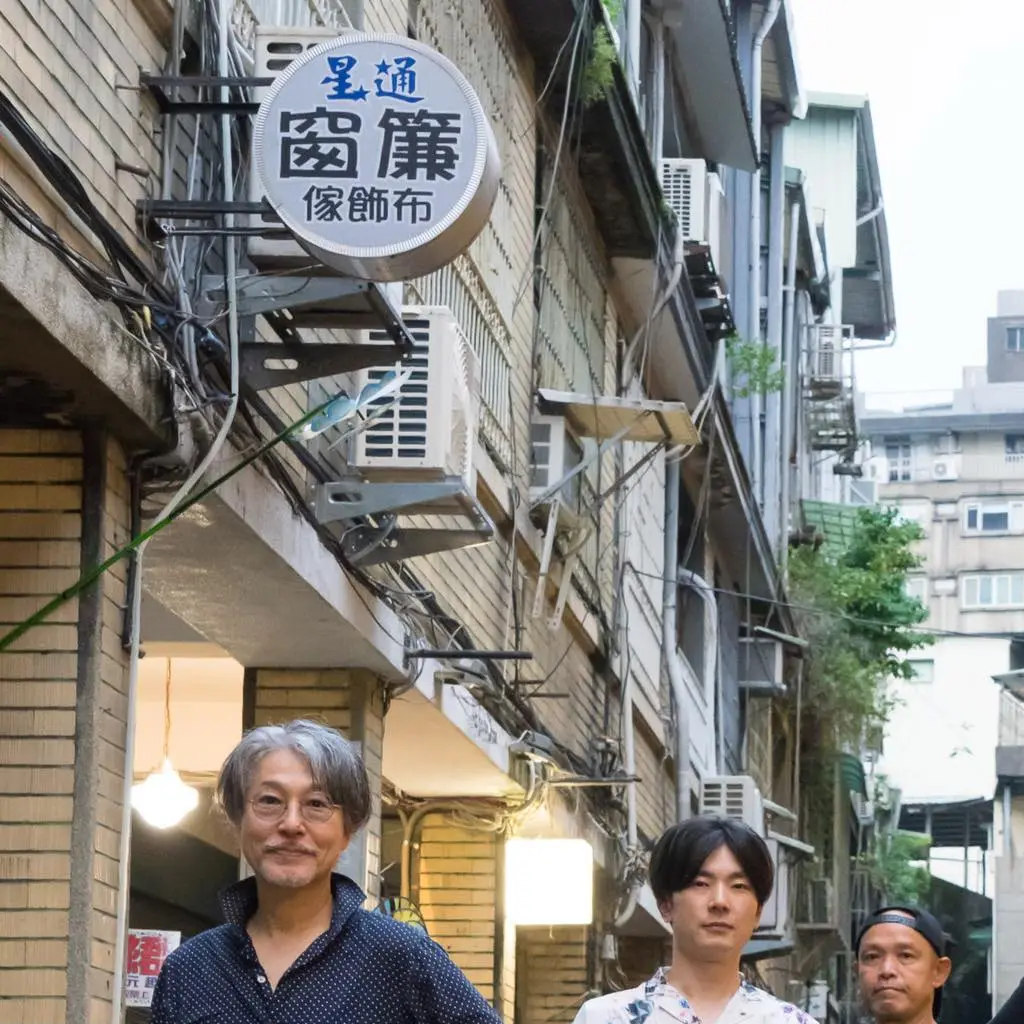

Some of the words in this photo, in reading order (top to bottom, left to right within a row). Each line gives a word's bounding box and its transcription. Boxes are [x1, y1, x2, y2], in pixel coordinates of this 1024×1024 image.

[320, 55, 425, 104] 星通
[279, 106, 462, 181] 窗簾
[303, 184, 434, 224] 傢飾布
